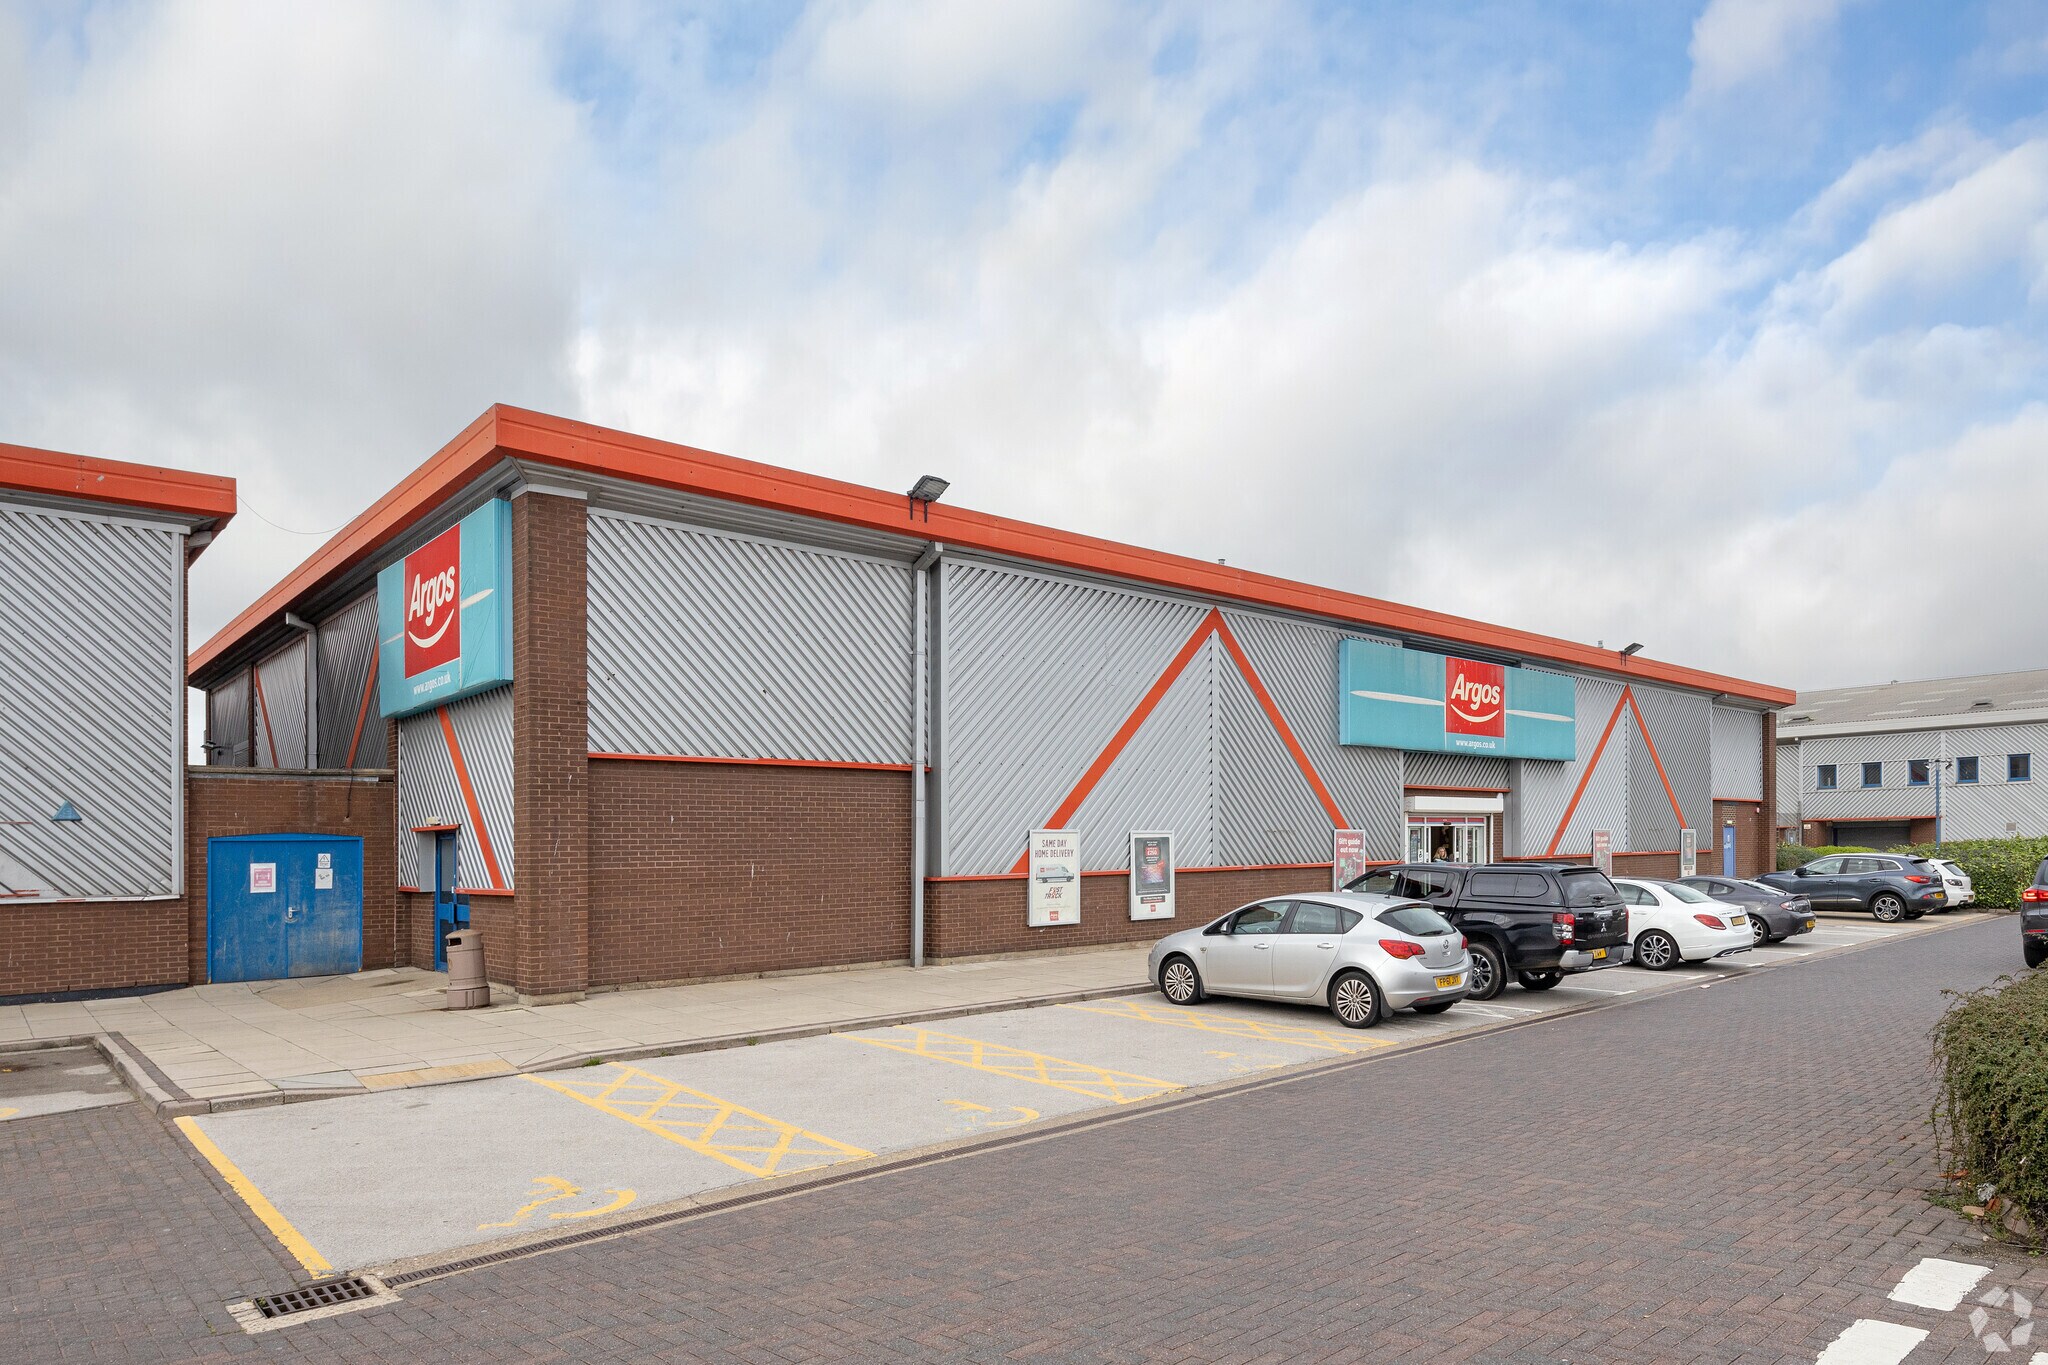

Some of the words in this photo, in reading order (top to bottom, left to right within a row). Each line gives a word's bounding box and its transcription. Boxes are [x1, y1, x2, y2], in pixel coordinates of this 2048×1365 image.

[408, 565, 455, 626] Argos
[413, 670, 451, 695] www.argos.co.uk
[1451, 673, 1500, 710] Argos
[1456, 740, 1496, 749] www.argos.co.uk
[1042, 839, 1056, 848] SAME
[1056, 839, 1067, 848] DAY
[1034, 849, 1049, 858] HOME
[1050, 849, 1074, 858] DELIVERY
